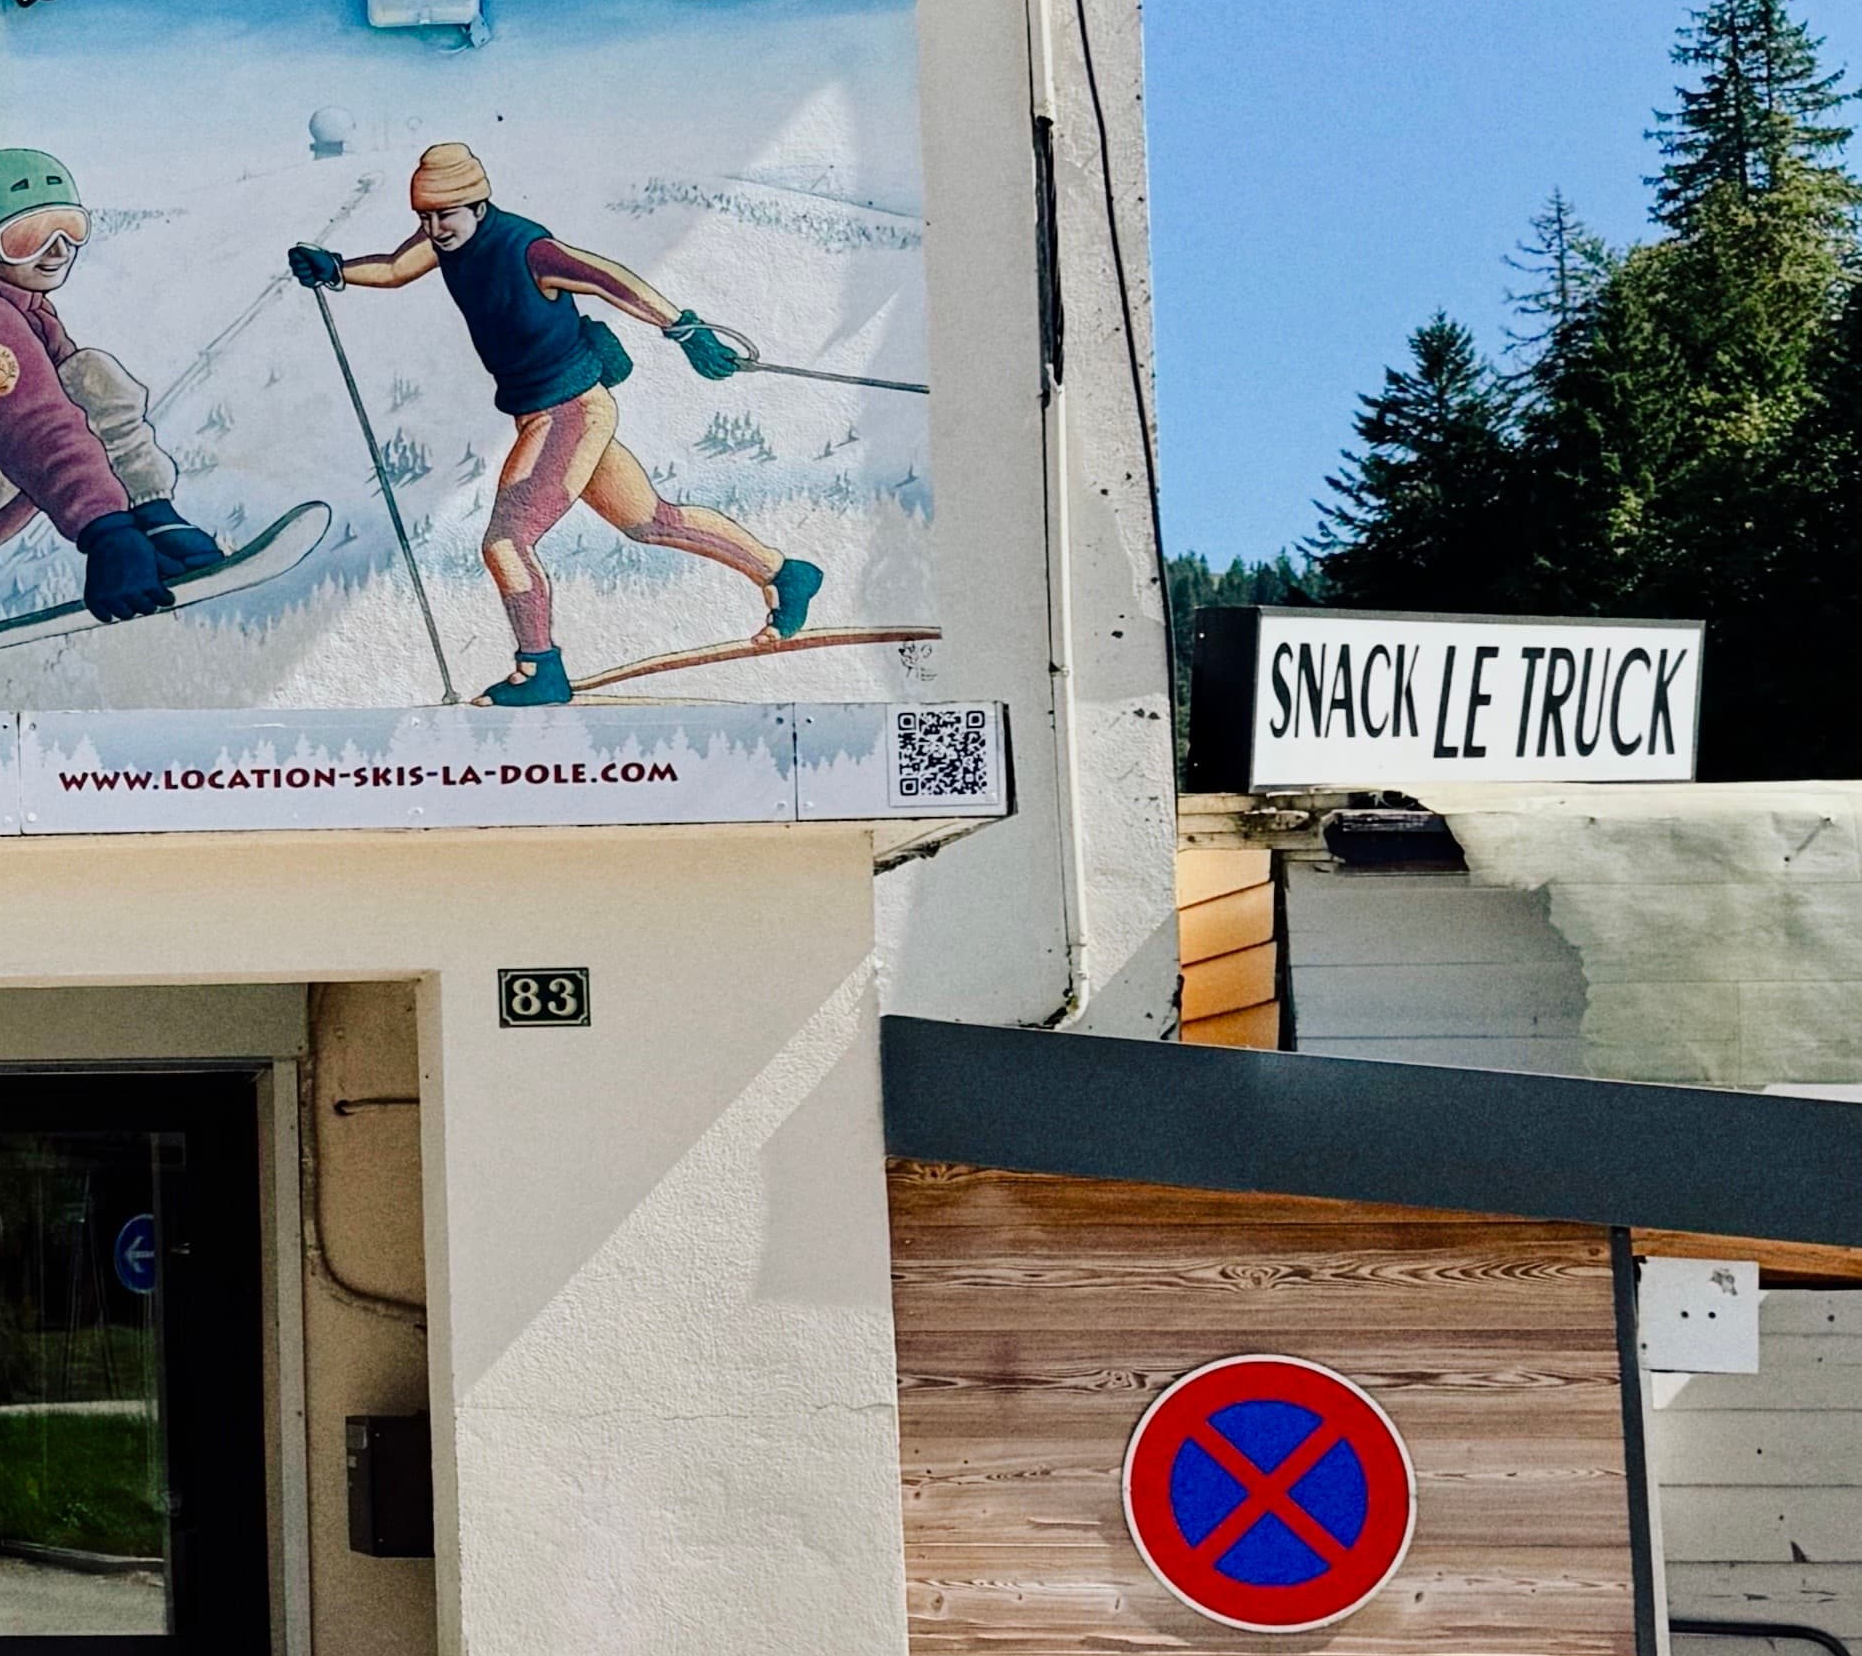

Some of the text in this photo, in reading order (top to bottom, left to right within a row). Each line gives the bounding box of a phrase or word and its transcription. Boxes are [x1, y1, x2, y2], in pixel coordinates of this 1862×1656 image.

[1269, 643, 1688, 758] SNACK LE TRUCK
[511, 977, 578, 1016] 83
